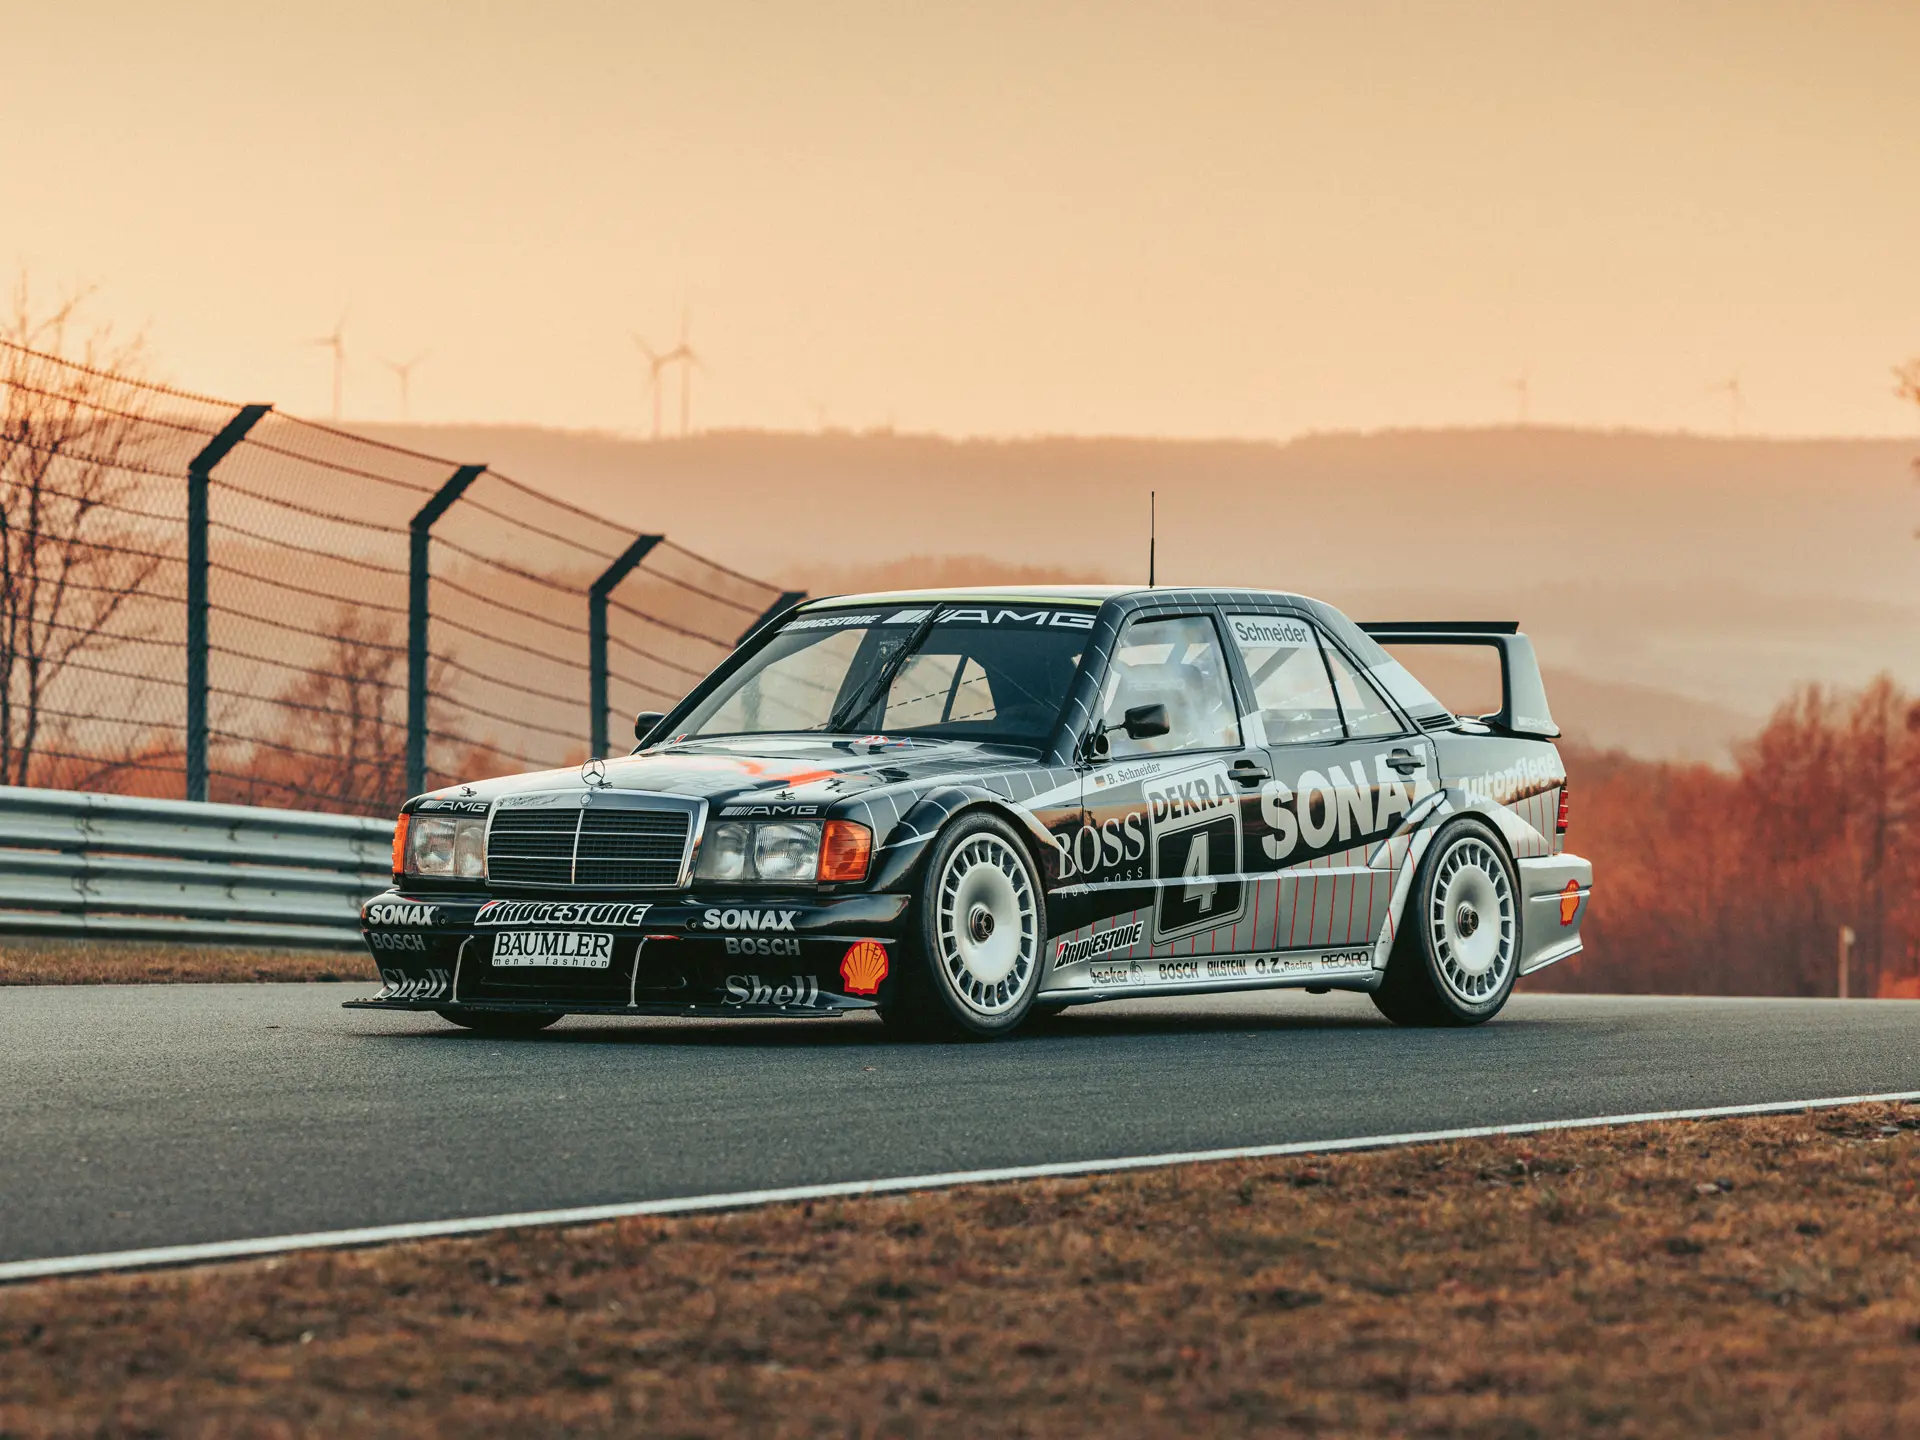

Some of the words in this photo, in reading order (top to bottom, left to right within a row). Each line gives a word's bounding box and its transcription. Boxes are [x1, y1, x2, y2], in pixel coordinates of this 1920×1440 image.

[940, 609, 1097, 629] AMG
[1234, 622, 1309, 643] Schneider
[1106, 773, 1118, 785] B.
[1119, 762, 1161, 782] Schneider
[1459, 753, 1557, 808] Autopflege
[437, 802, 489, 812] AMG
[1148, 773, 1235, 824] DEKRA
[1261, 743, 1454, 860] SONAX
[750, 805, 818, 815] AMG
[1054, 811, 1146, 880] BOSS
[1182, 831, 1218, 912] 4
[368, 904, 436, 926] SONAX
[474, 900, 653, 926] BRIDGESTONE
[703, 908, 796, 931] SONAX
[370, 932, 426, 951] BOSCH
[495, 932, 610, 958] BÄUMLER
[725, 937, 801, 956] BOSCH
[545, 956, 608, 968] fashion
[1158, 961, 1199, 981] BOSCH
[1207, 959, 1247, 977] BILSTEIN
[1284, 960, 1313, 972] Racing
[1321, 951, 1369, 970] RECARO
[372, 968, 448, 999] Shell
[1090, 967, 1127, 984] becker
[720, 975, 819, 1008] Shell
